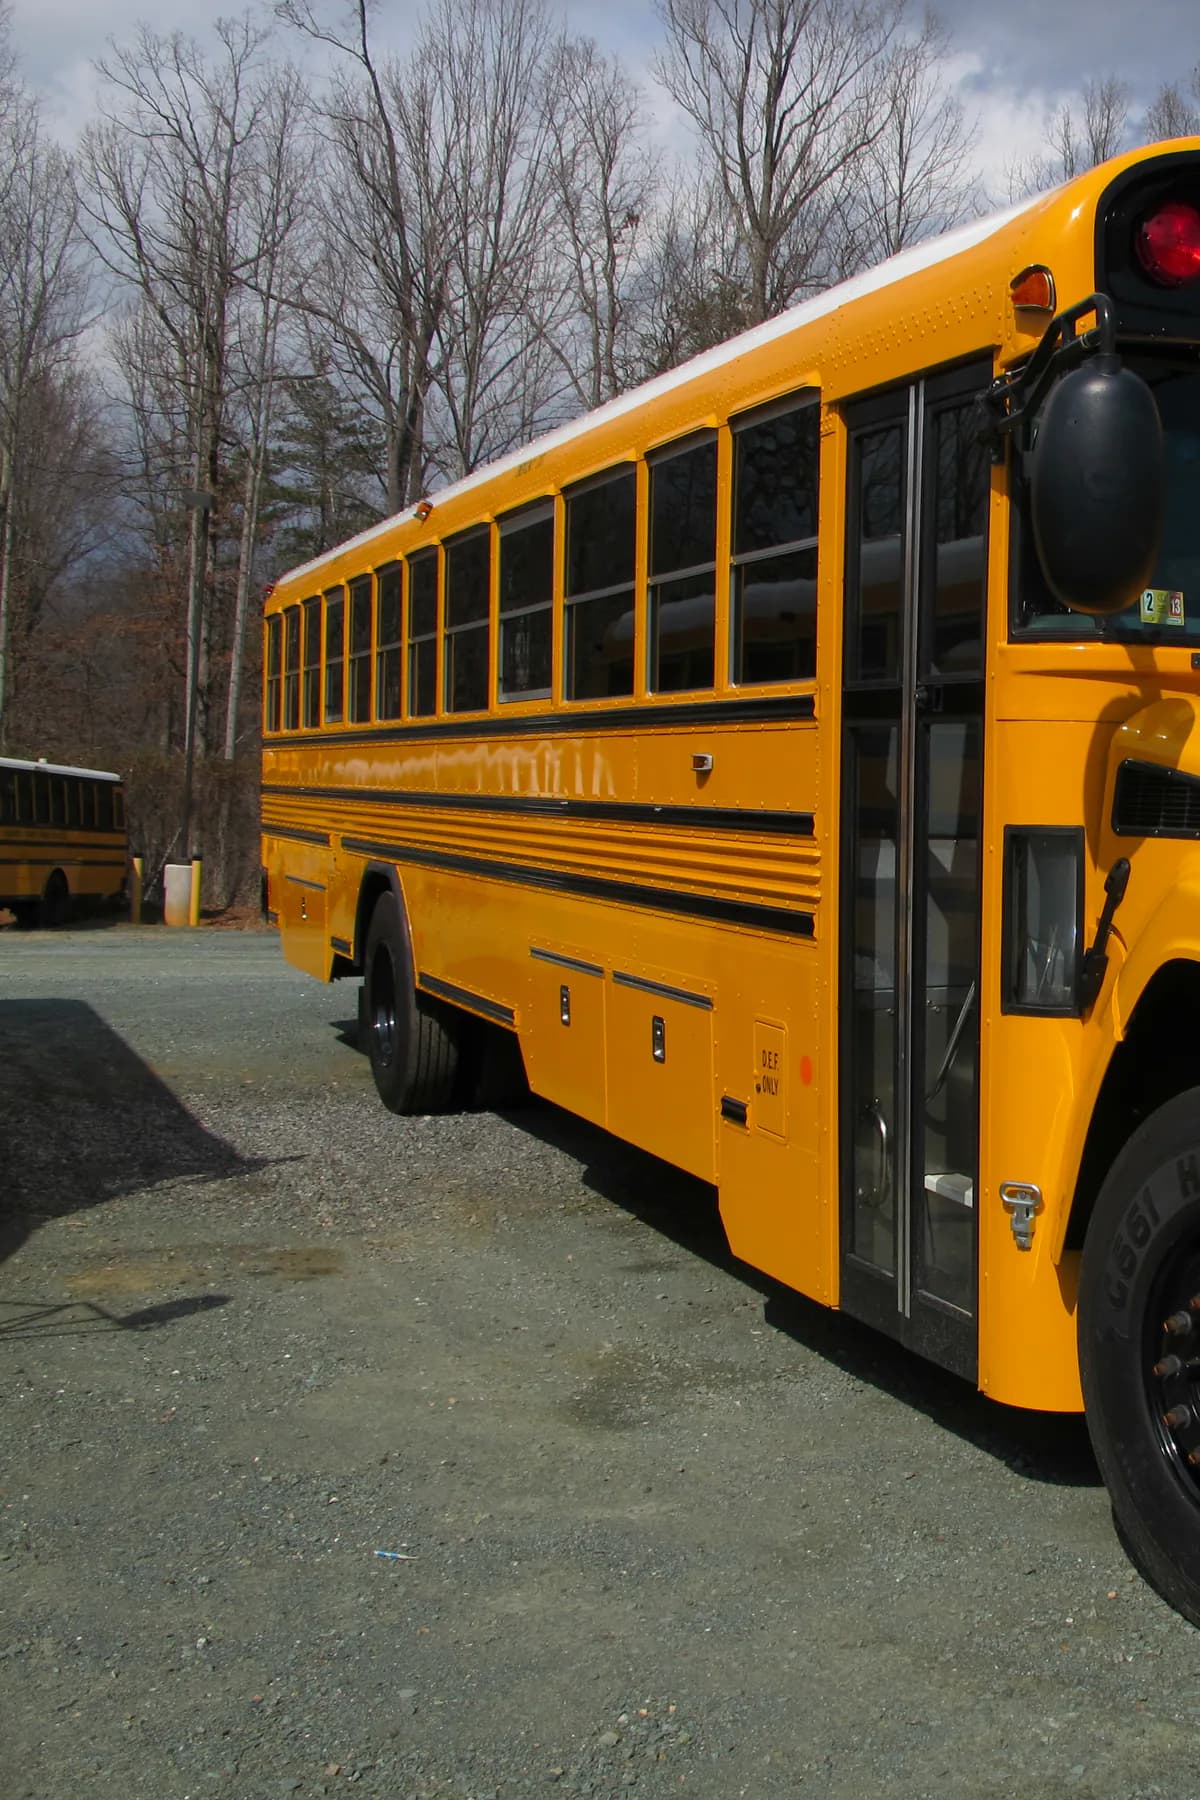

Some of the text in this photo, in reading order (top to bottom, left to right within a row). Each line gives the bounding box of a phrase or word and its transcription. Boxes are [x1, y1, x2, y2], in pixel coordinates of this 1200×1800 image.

[1146, 592, 1154, 612] 2
[1171, 598, 1181, 614] 13
[762, 1075, 779, 1097] ONLY
